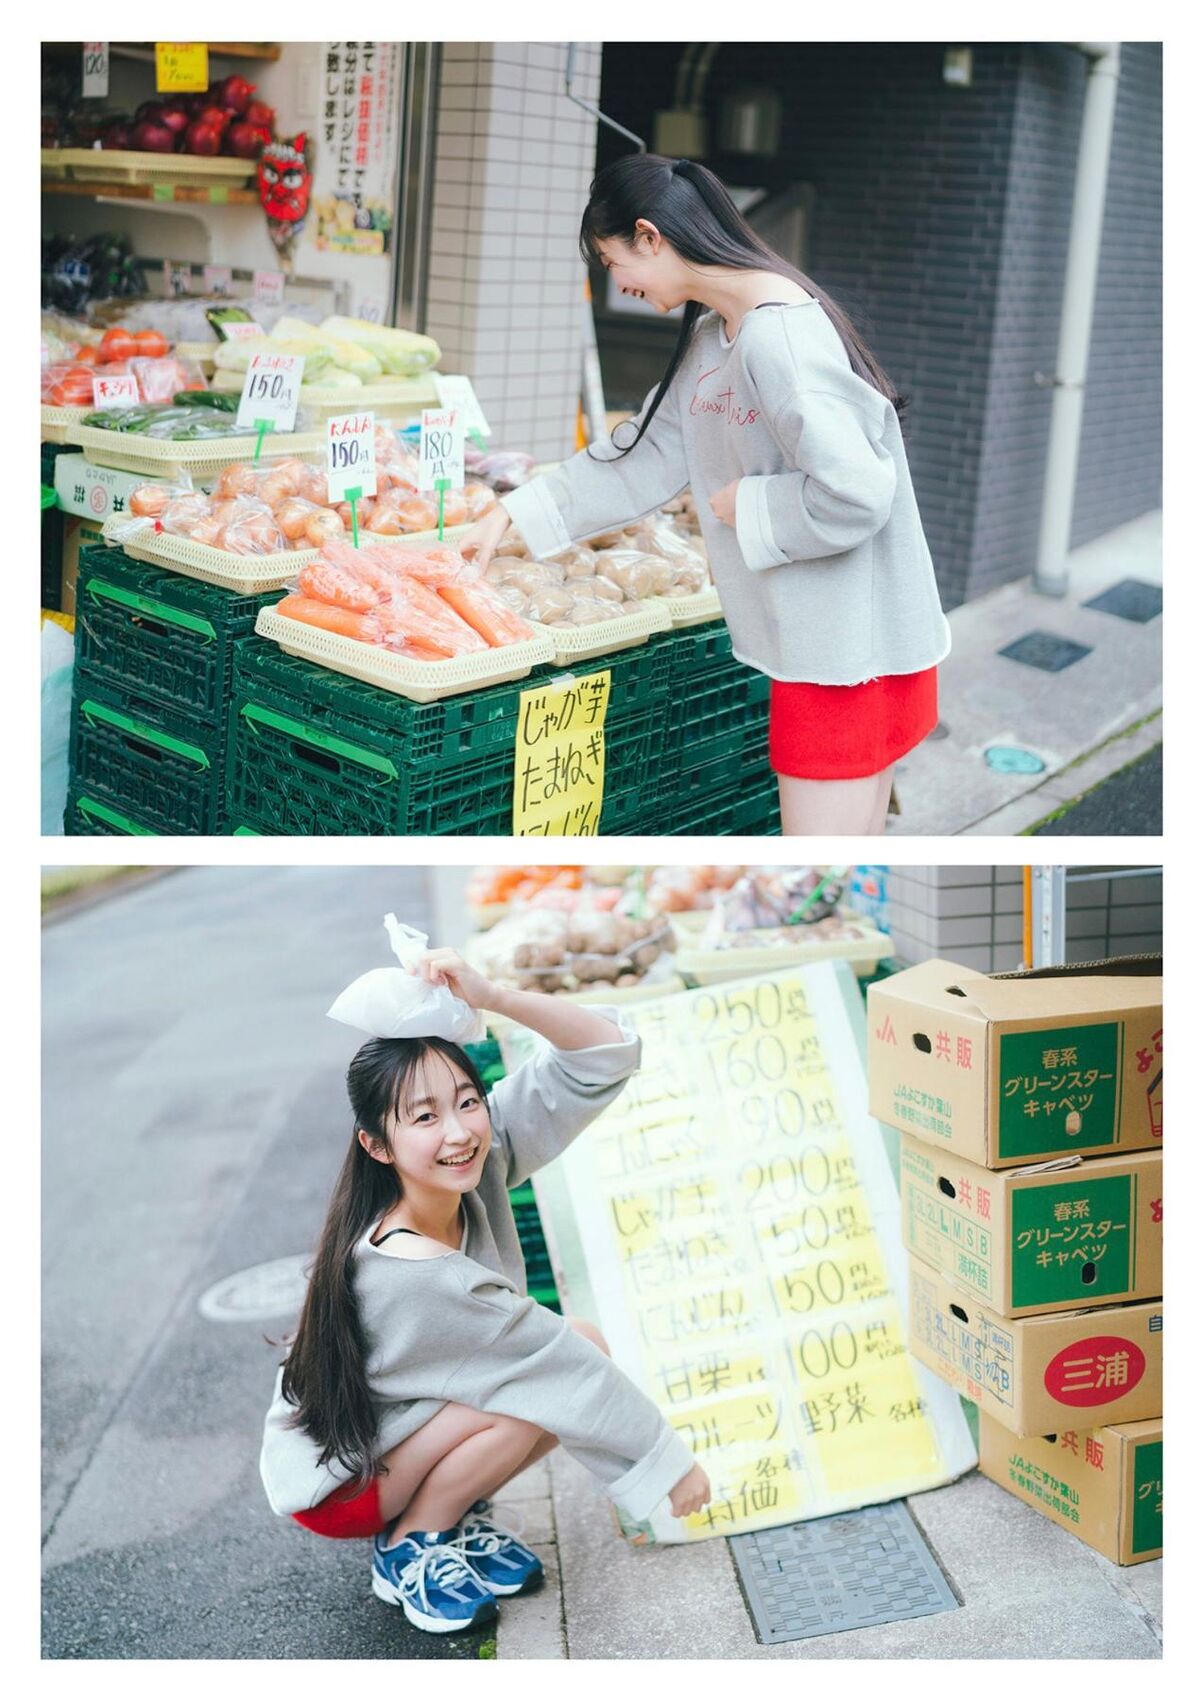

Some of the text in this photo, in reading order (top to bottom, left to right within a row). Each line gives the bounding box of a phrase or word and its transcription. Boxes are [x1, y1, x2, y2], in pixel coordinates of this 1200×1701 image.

[424, 431, 453, 461] 180
[523, 677, 607, 746] じゃが芋
[521, 730, 604, 813] たまねぎ
[1041, 1047, 1078, 1069] 春系
[1004, 1068, 1114, 1097] グリーンスター
[1023, 1093, 1095, 1118] キャベツ
[958, 1176, 992, 1220] 共販
[1053, 1199, 1091, 1222] 春系
[979, 1234, 988, 1256] B
[1017, 1220, 1127, 1250] グリーンスター
[1035, 1243, 1109, 1269] キャベツ
[1061, 1350, 1129, 1393] 三浦
[800, 1382, 876, 1435] 野菜
